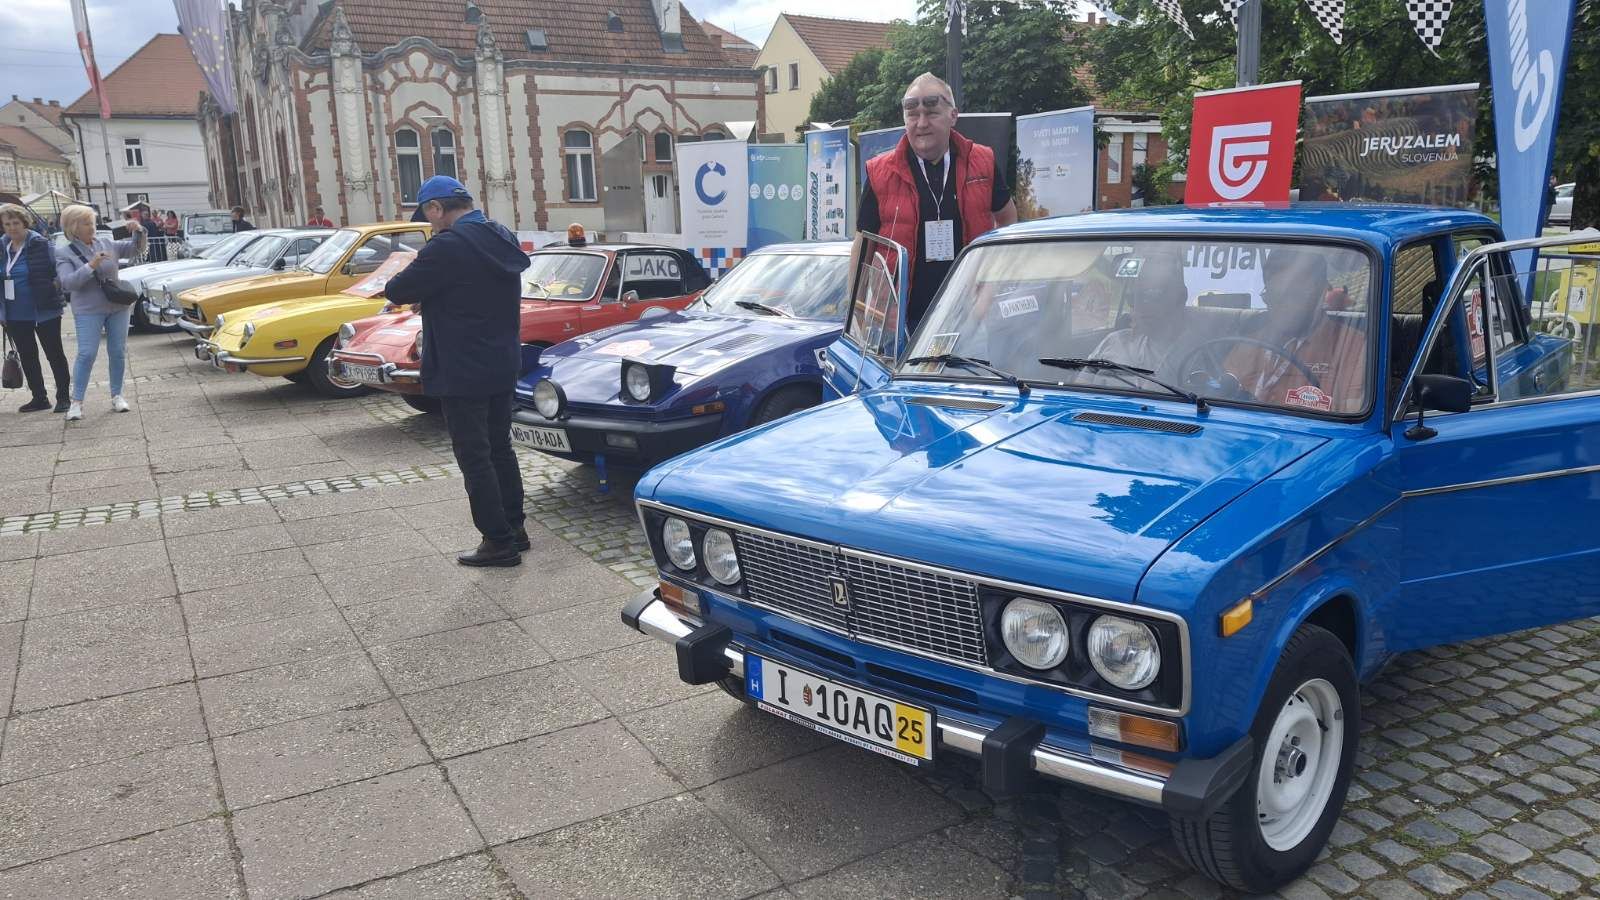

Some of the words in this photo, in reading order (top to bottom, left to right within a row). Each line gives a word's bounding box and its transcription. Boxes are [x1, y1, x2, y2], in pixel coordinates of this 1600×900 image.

[1360, 133, 1461, 157] JERUZALEM
[1401, 152, 1459, 163] SLOVENIJA
[529, 429, 565, 448] 78-ADA
[751, 678, 759, 693] H
[815, 684, 894, 742] 10AQ
[897, 716, 924, 744] 25
